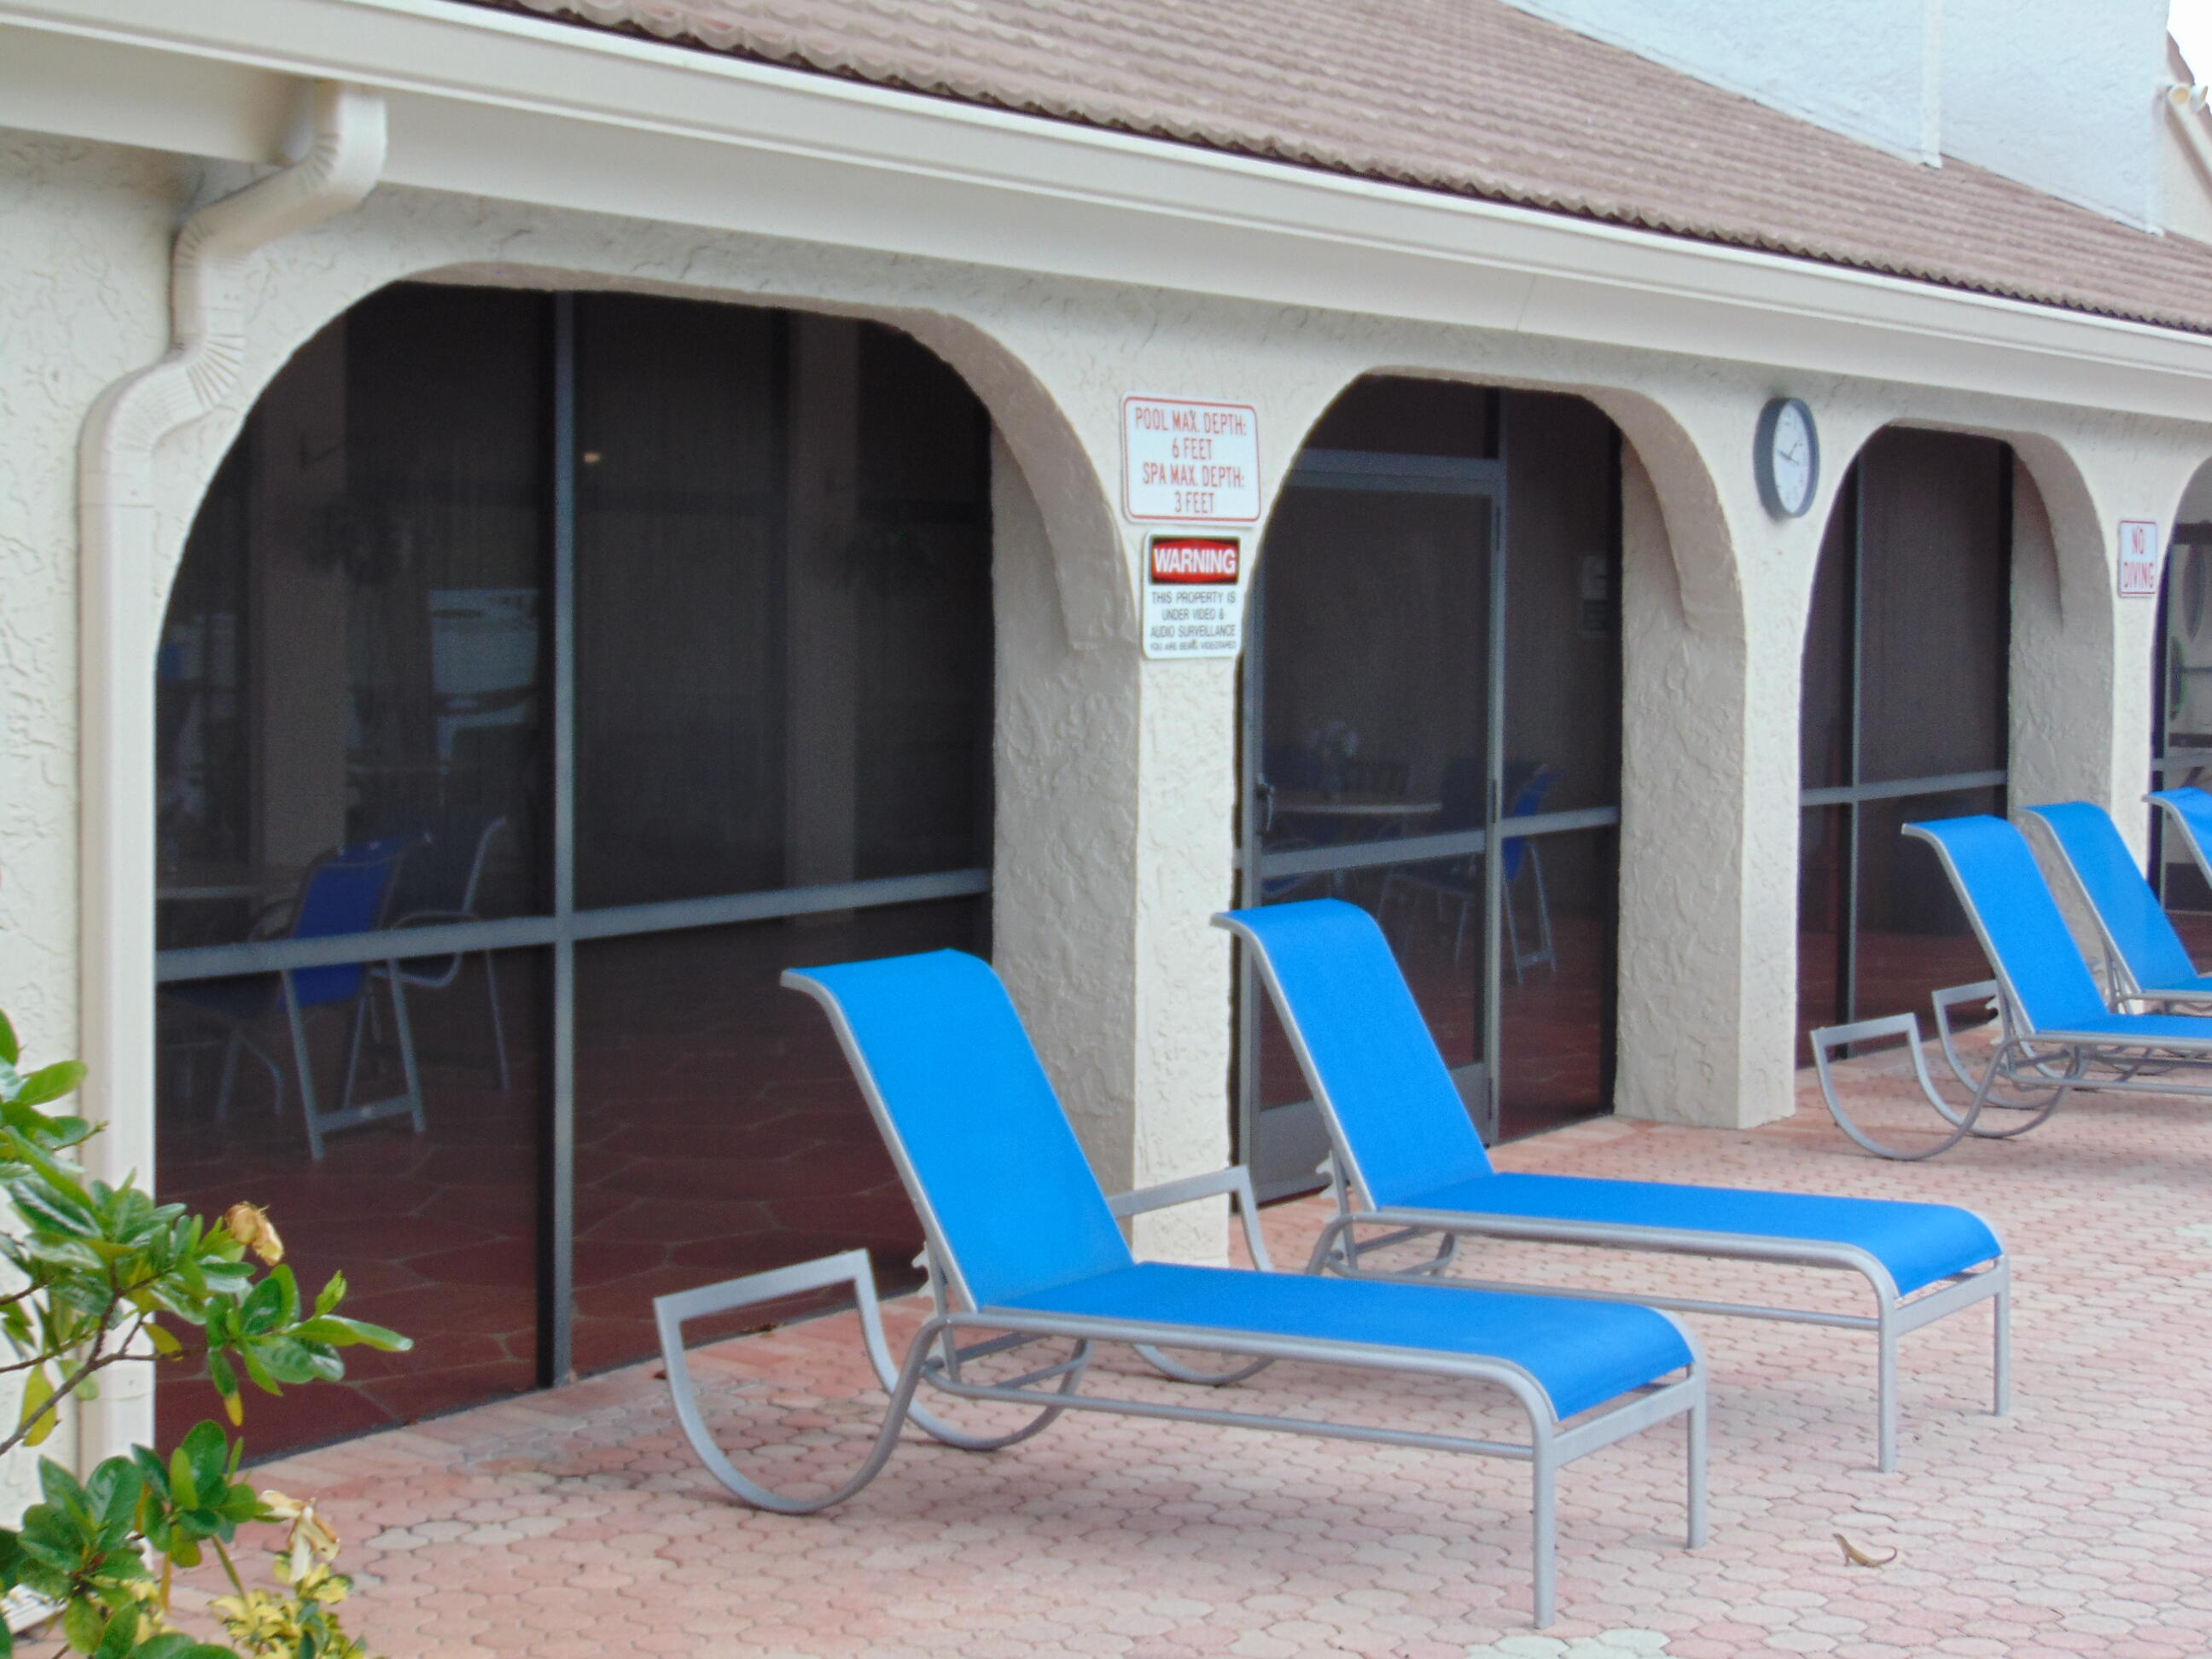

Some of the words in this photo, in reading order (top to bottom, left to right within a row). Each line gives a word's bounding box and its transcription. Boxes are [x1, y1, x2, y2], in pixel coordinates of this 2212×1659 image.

[1135, 407, 1168, 431] POOL
[1172, 410, 1200, 433] MAX.
[1203, 412, 1247, 436] DEPTH:
[1172, 437, 1179, 458] 6
[1184, 437, 1213, 460] FEET
[1143, 463, 1167, 485] SPA
[1170, 464, 1198, 486] MAX.
[1202, 466, 1244, 488] DEPTH:
[1174, 492, 1182, 513] 3
[1186, 492, 1214, 514] FEET
[2132, 527, 2145, 555] NO
[1153, 548, 1237, 574] WARNING
[2123, 562, 2154, 588] DIVING
[1151, 591, 1173, 604] THIS
[1176, 591, 1224, 604] PROPERTY
[1227, 591, 1237, 603] IS
[1161, 608, 1190, 620] UNDER
[1193, 608, 1216, 620] VIDEO
[1219, 608, 1225, 620] &
[1150, 626, 1174, 638] AUDIO
[1179, 625, 1236, 637] SURVEILLANCE
